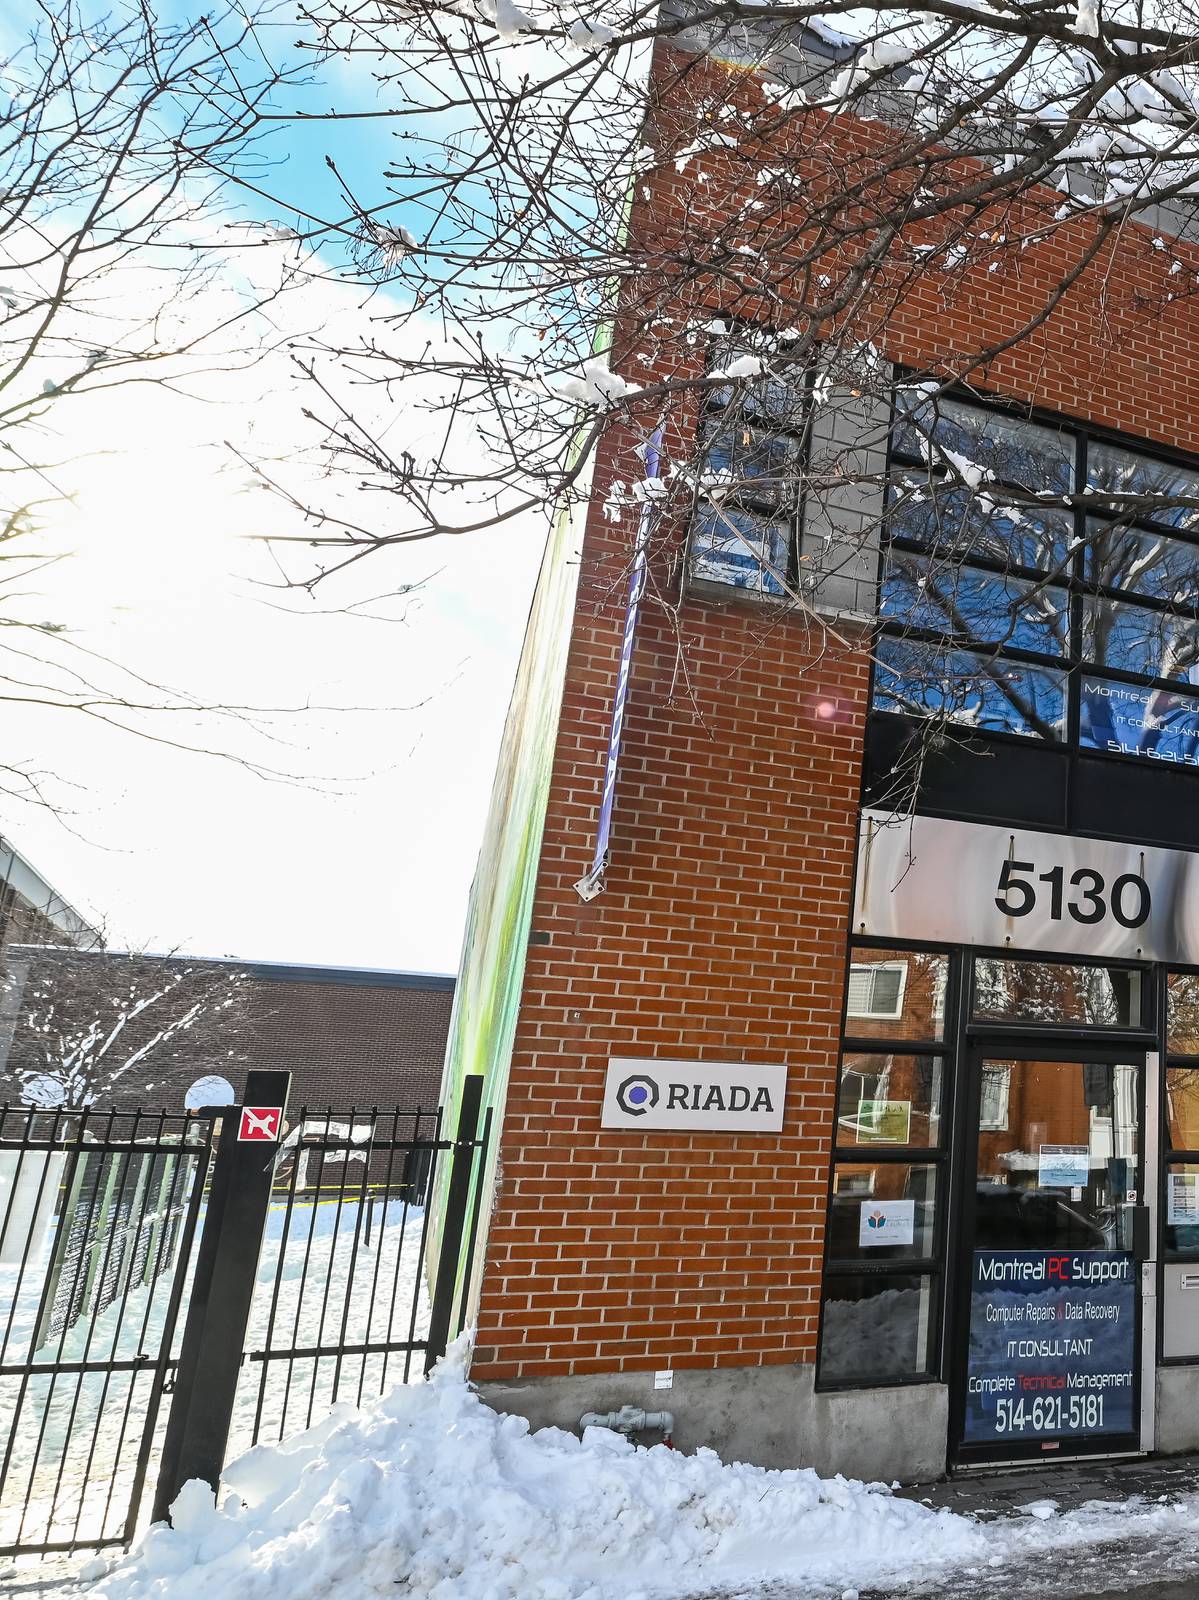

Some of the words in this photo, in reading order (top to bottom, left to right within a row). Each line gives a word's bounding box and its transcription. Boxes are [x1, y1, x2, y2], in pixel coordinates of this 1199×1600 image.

[1084, 683, 1153, 705] Montreal
[1116, 716, 1127, 724] IT
[994, 860, 1152, 929] 5130
[666, 1083, 774, 1113] RIADA
[978, 1258, 1046, 1281] Montreal
[1048, 1257, 1070, 1281] PC
[1072, 1257, 1129, 1283] Support
[986, 1303, 1025, 1325] Computer
[1026, 1302, 1056, 1324] Repairs
[1065, 1302, 1083, 1320] Data
[1085, 1302, 1120, 1323] Recovery
[1007, 1341, 1017, 1358] IT
[1019, 1339, 1093, 1358] CONSULTANT
[968, 1375, 1016, 1395] Complete
[1017, 1373, 1066, 1391] Technical
[1067, 1370, 1133, 1391] Management
[995, 1394, 1104, 1433] 514-621-5181
